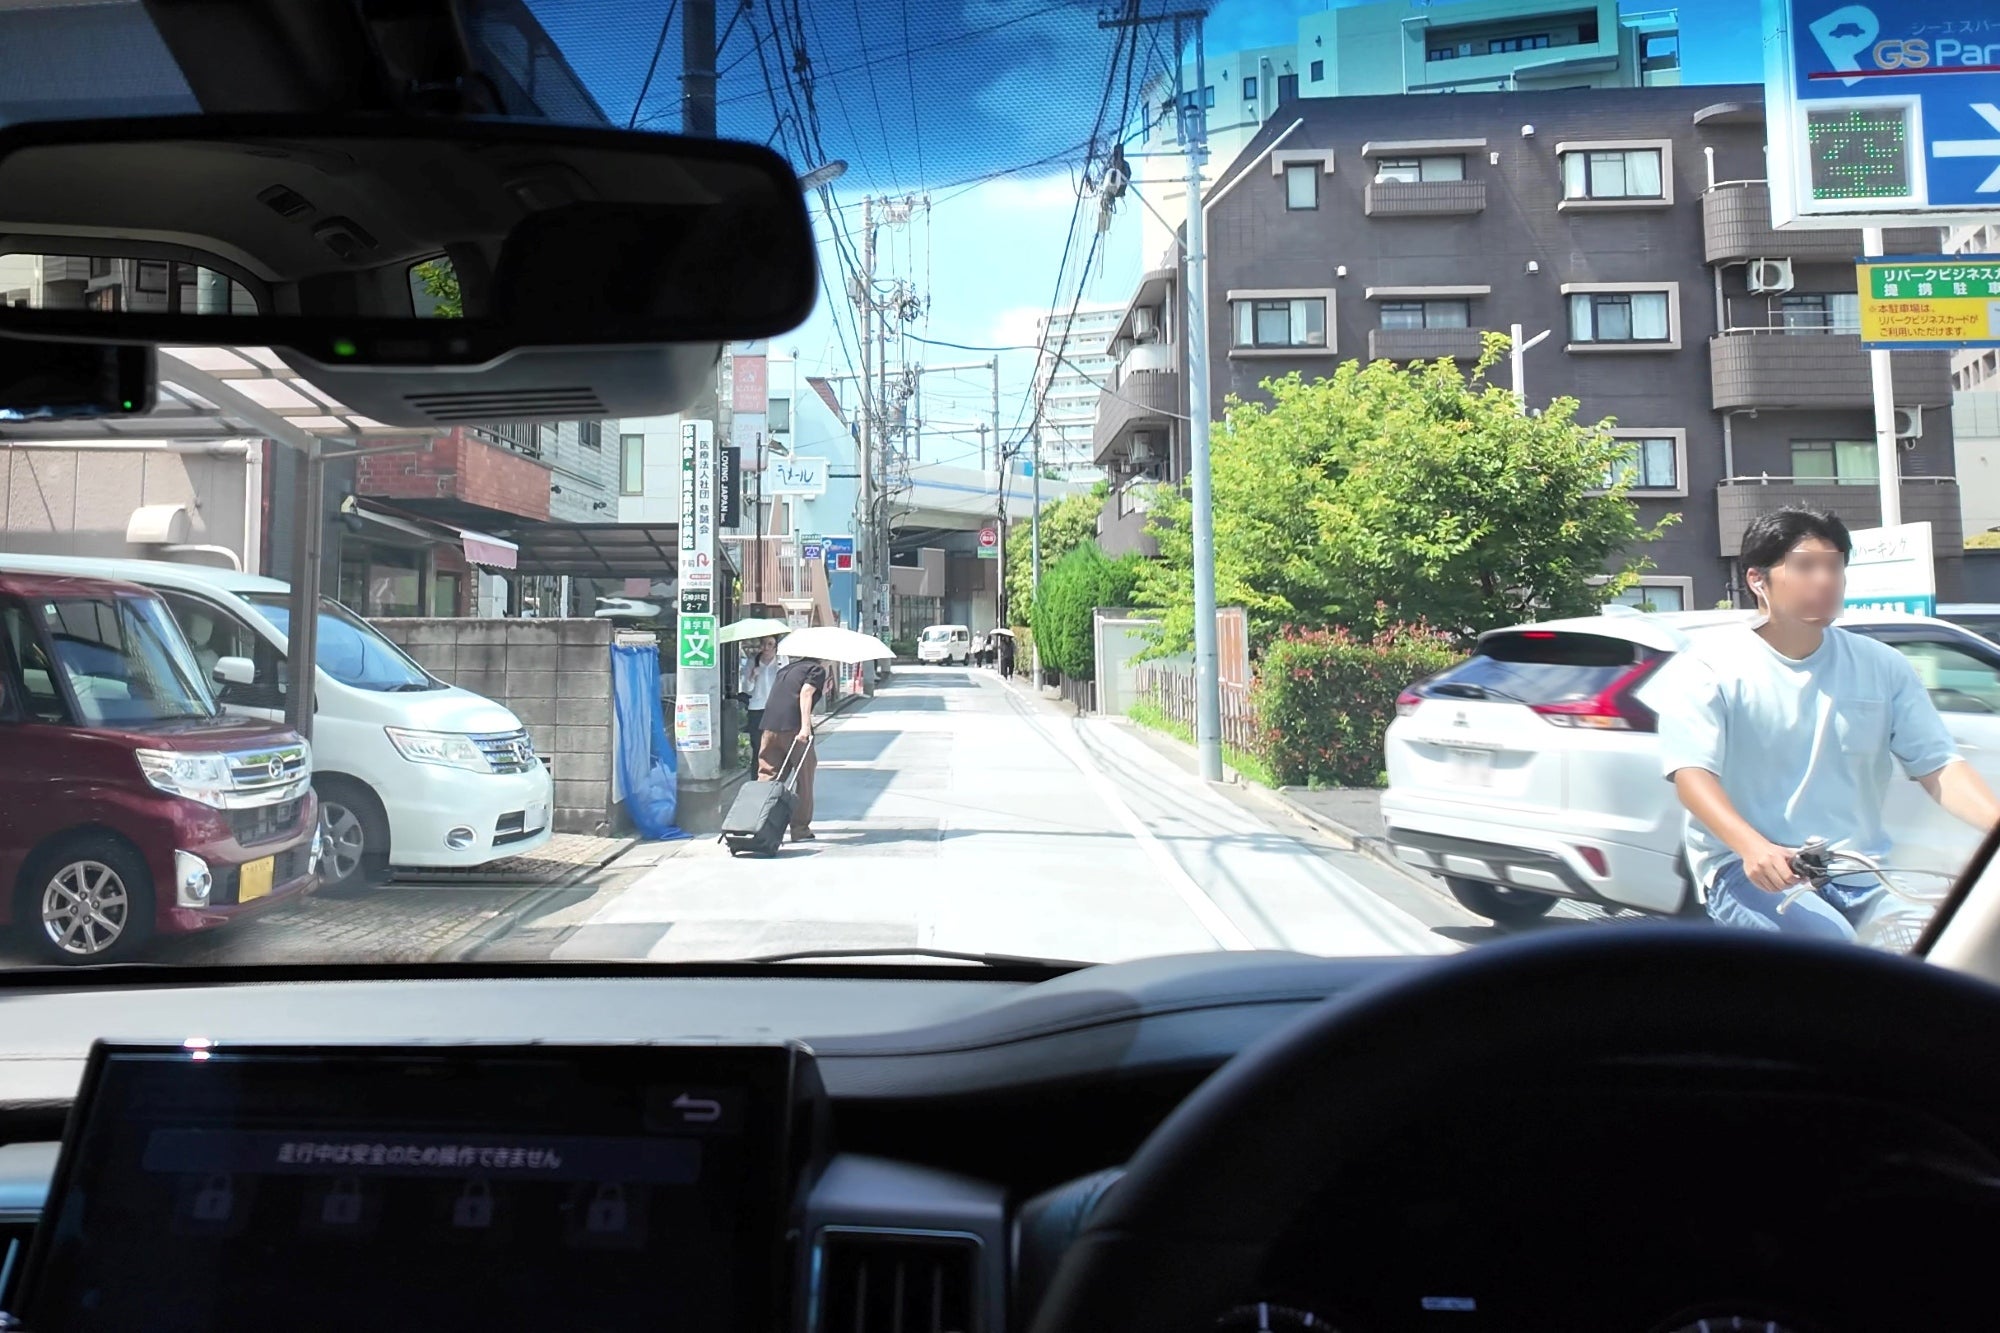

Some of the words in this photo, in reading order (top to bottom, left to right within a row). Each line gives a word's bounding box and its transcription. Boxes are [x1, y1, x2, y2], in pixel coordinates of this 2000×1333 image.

[1873, 38, 1930, 70] GS
[1808, 111, 1908, 200] 空
[721, 450, 729, 482] LOVING
[721, 483, 729, 512] JAPAN
[686, 603, 702, 611] 2-7
[683, 631, 710, 659] 文
[276, 1142, 563, 1169] 走行中は安全のため操作できません
